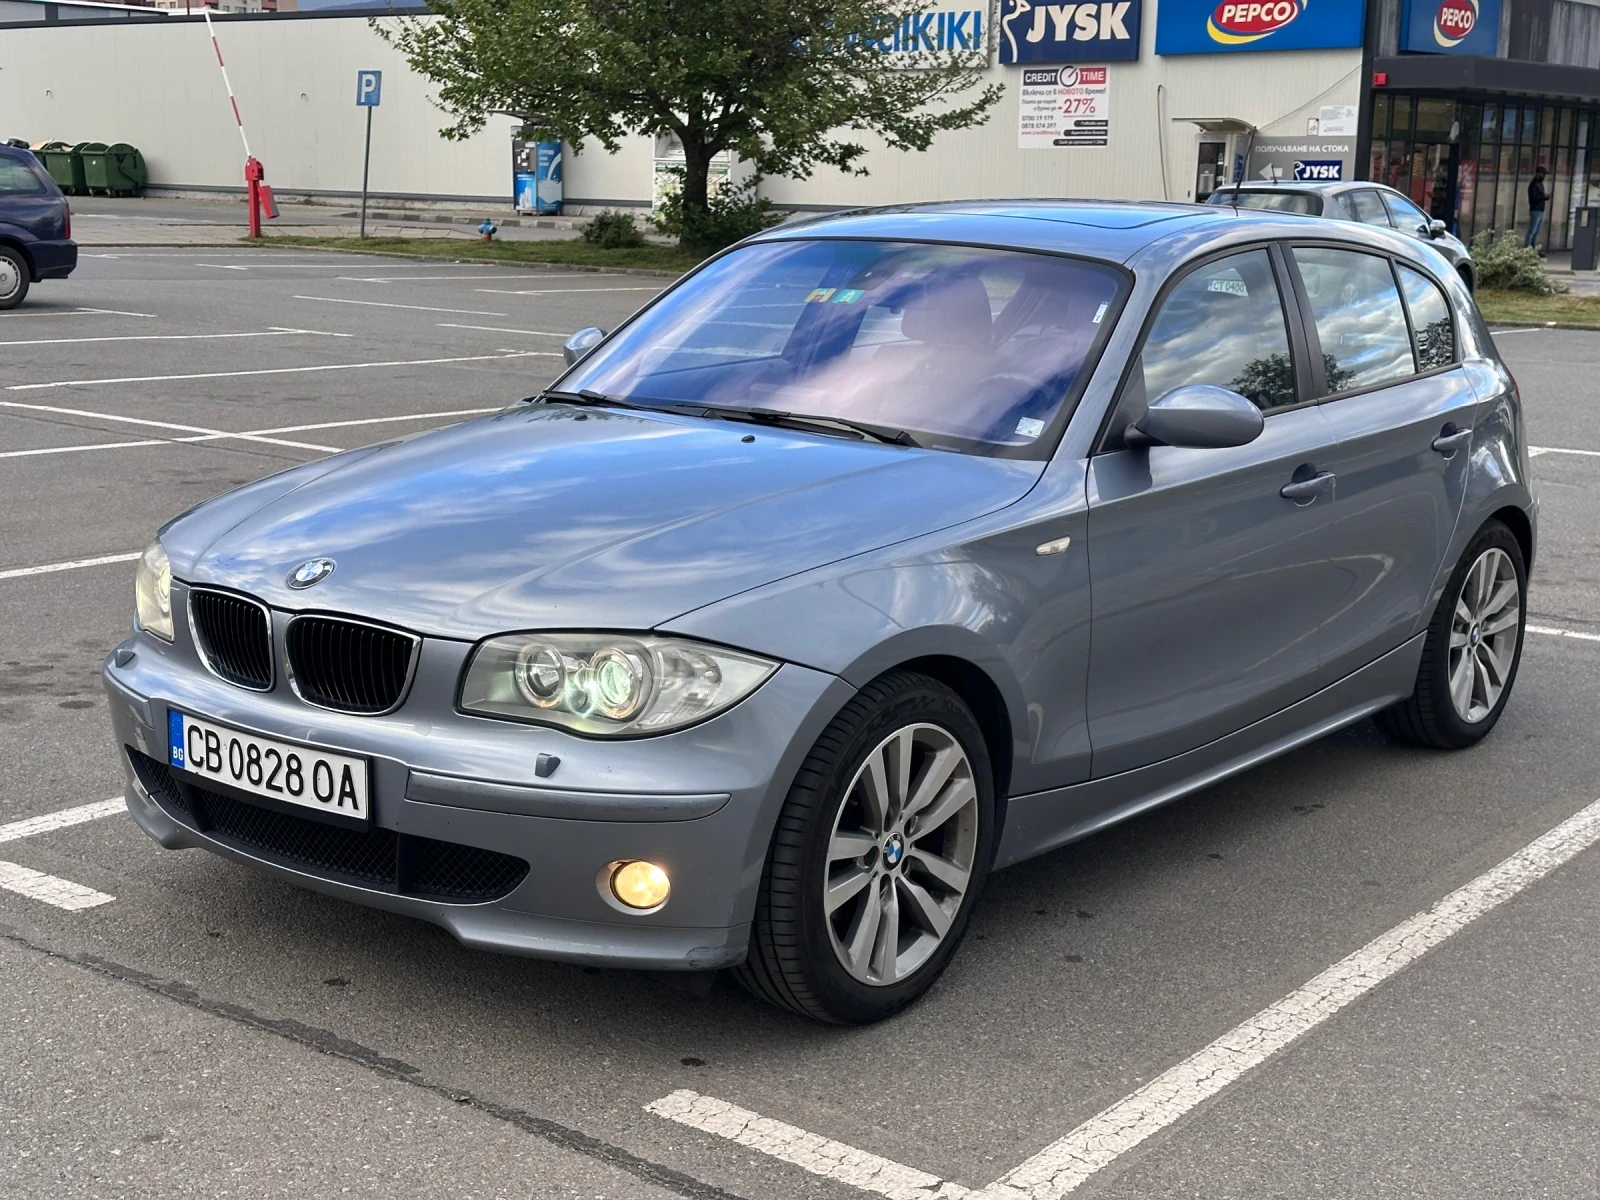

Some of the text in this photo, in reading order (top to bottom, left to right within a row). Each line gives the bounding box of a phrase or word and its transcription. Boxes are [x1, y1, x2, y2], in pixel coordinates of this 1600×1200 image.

[1221, 2, 1292, 23] PEPCO
[1440, 7, 1473, 28] PEPCO
[1025, 2, 1132, 43] JYSK
[1025, 71, 1105, 82] CREDIT TIME
[360, 73, 377, 103] P
[1058, 87, 1084, 95] НОВОТО
[1058, 97, 1096, 114] -27%
[1255, 145, 1308, 153] ПОЛУЧАВАНЕ
[1303, 165, 1340, 178] JYSK
[172, 745, 184, 761] BG
[228, 737, 304, 796] 0828
